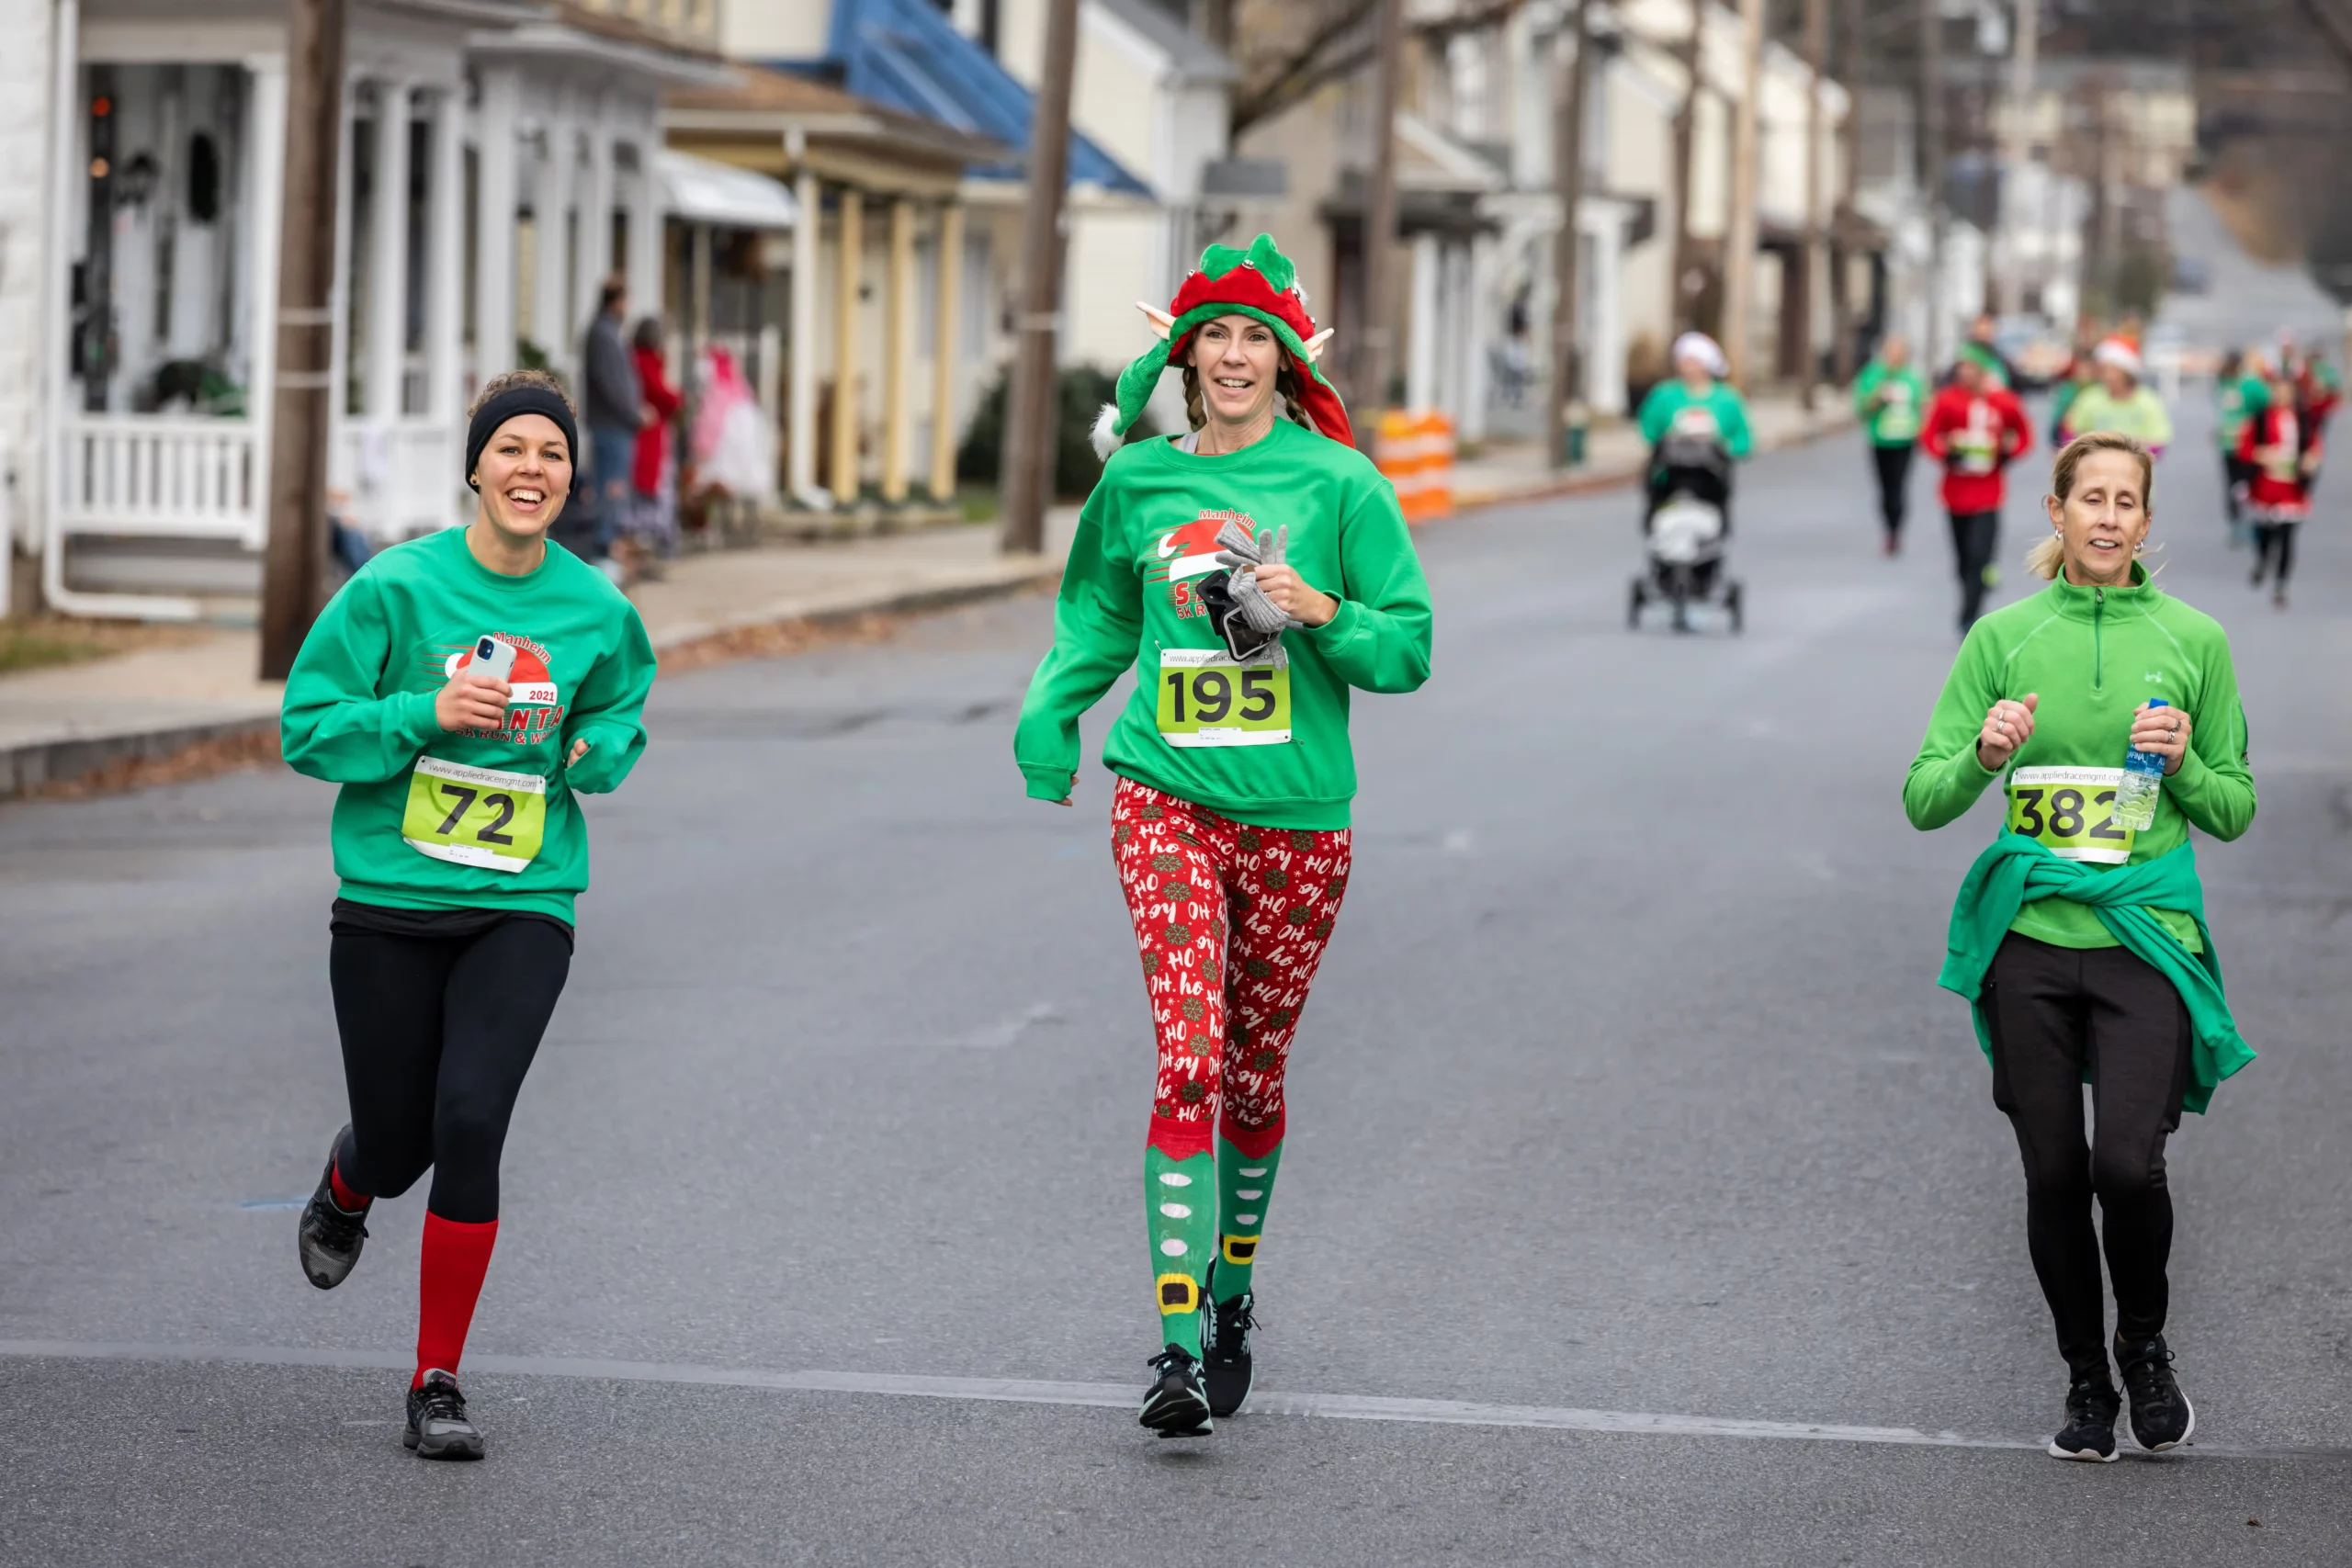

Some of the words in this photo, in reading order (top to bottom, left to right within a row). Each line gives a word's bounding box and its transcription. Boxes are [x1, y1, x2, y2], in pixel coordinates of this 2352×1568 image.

[1199, 508, 1257, 530] Manheim
[1176, 605, 1193, 619] 5K
[493, 632, 552, 664] Manheim
[529, 690, 555, 702] 2021
[1168, 671, 1276, 723] 195
[496, 705, 564, 730] NTA
[480, 730, 512, 742] RUN
[514, 732, 526, 745] &
[429, 763, 537, 787] www.appliedracemgmt.com
[435, 784, 514, 845] 72
[2015, 789, 2126, 840] 382
[1138, 822, 1166, 839] HO
[1186, 850, 1209, 867] HO
[1235, 852, 1261, 872] HO
[1304, 854, 1332, 874] HO
[1134, 874, 1158, 898] HO
[1258, 893, 1287, 913] HO
[1167, 947, 1194, 971] HO
[1250, 982, 1281, 1003] HO
[1165, 1020, 1186, 1045] HO
[1260, 1029, 1286, 1048] HO
[1177, 1103, 1200, 1122] HO
